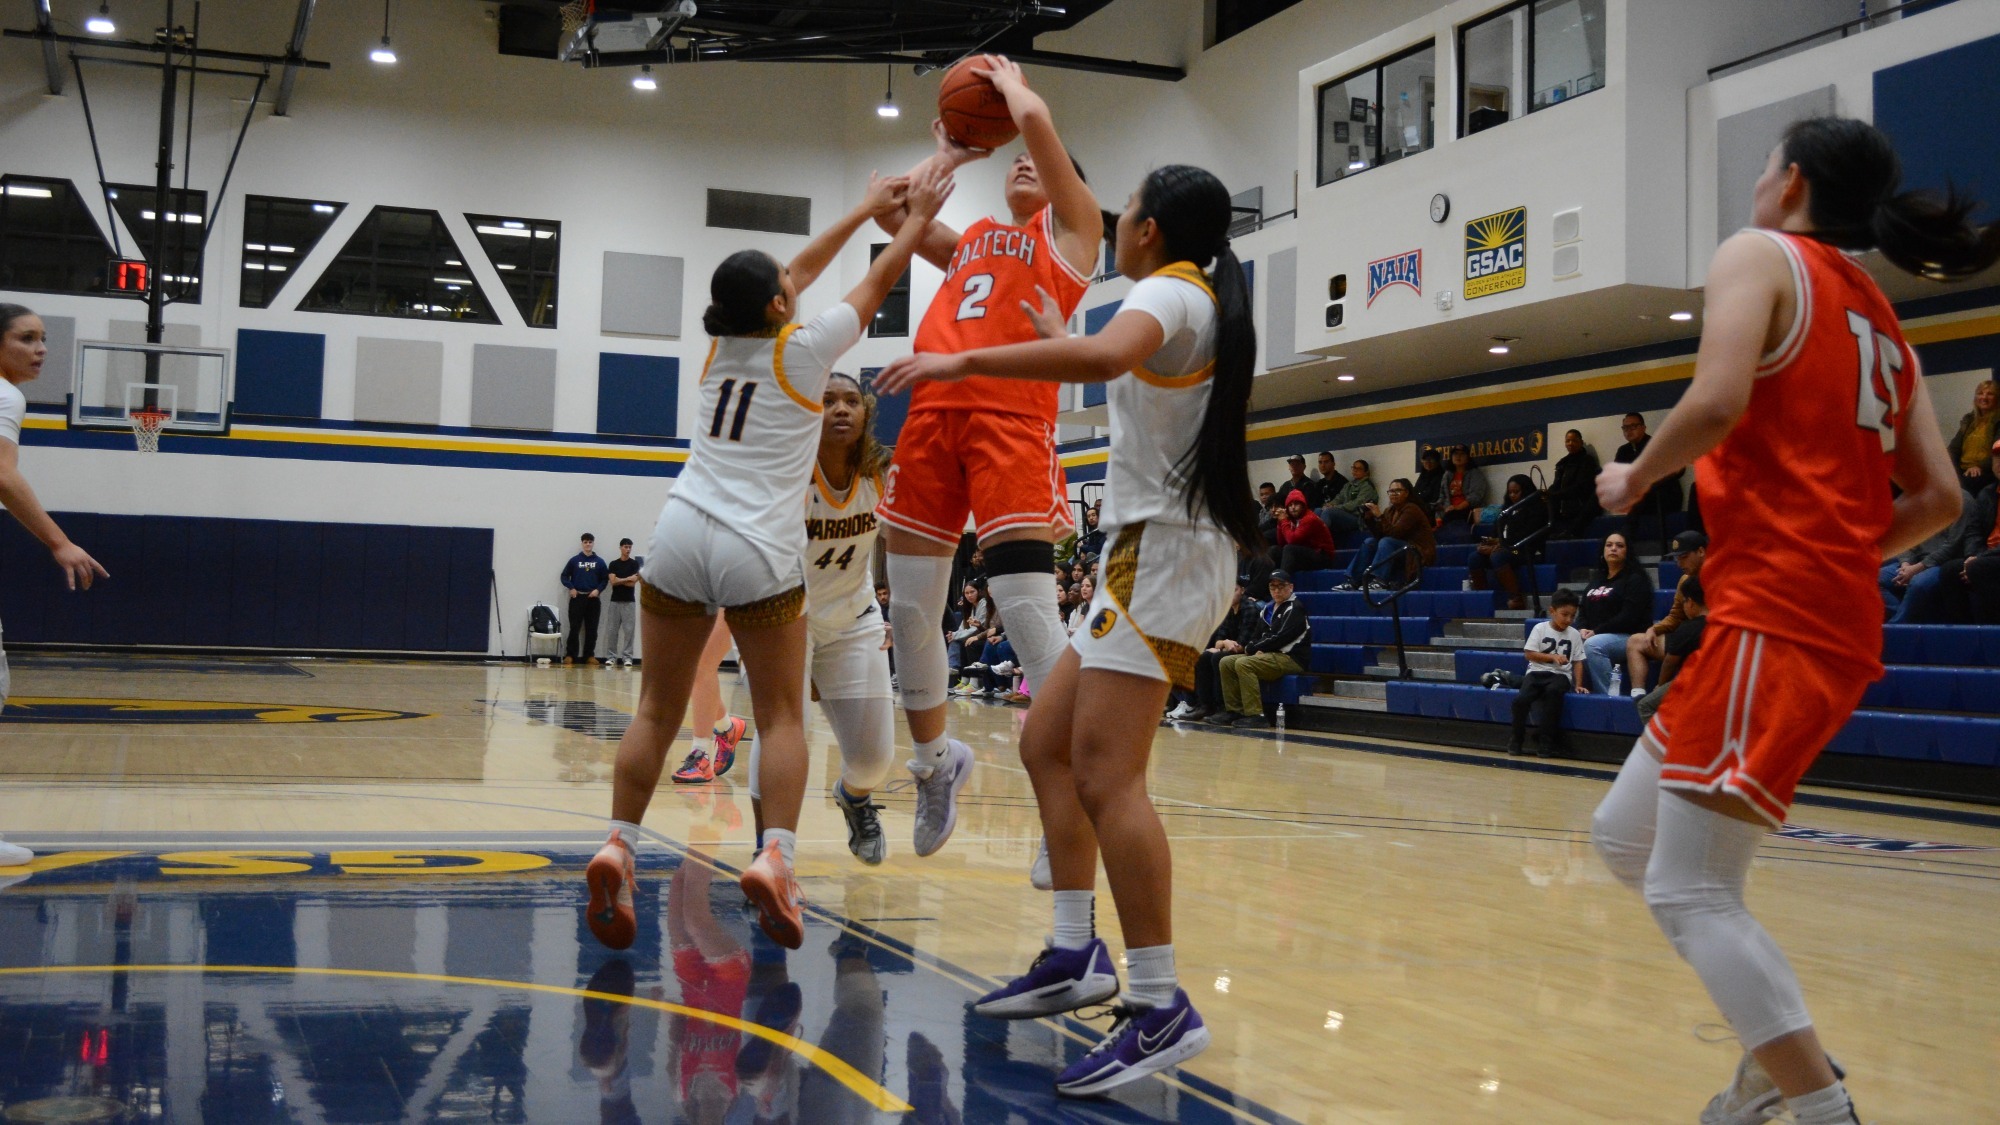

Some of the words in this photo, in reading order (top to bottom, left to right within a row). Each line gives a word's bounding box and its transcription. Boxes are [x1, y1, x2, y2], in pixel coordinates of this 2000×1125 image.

[946, 230, 1036, 282] CALTECH
[1466, 243, 1523, 280] GSAC
[119, 262, 146, 290] 17
[1368, 252, 1420, 299] NAIA
[1466, 276, 1523, 296] CONFERENCE
[956, 273, 995, 321] 2
[709, 378, 758, 442] 11
[1469, 436, 1525, 458] ARRACKS
[814, 544, 856, 570] 44
[1541, 636, 1572, 662] 23
